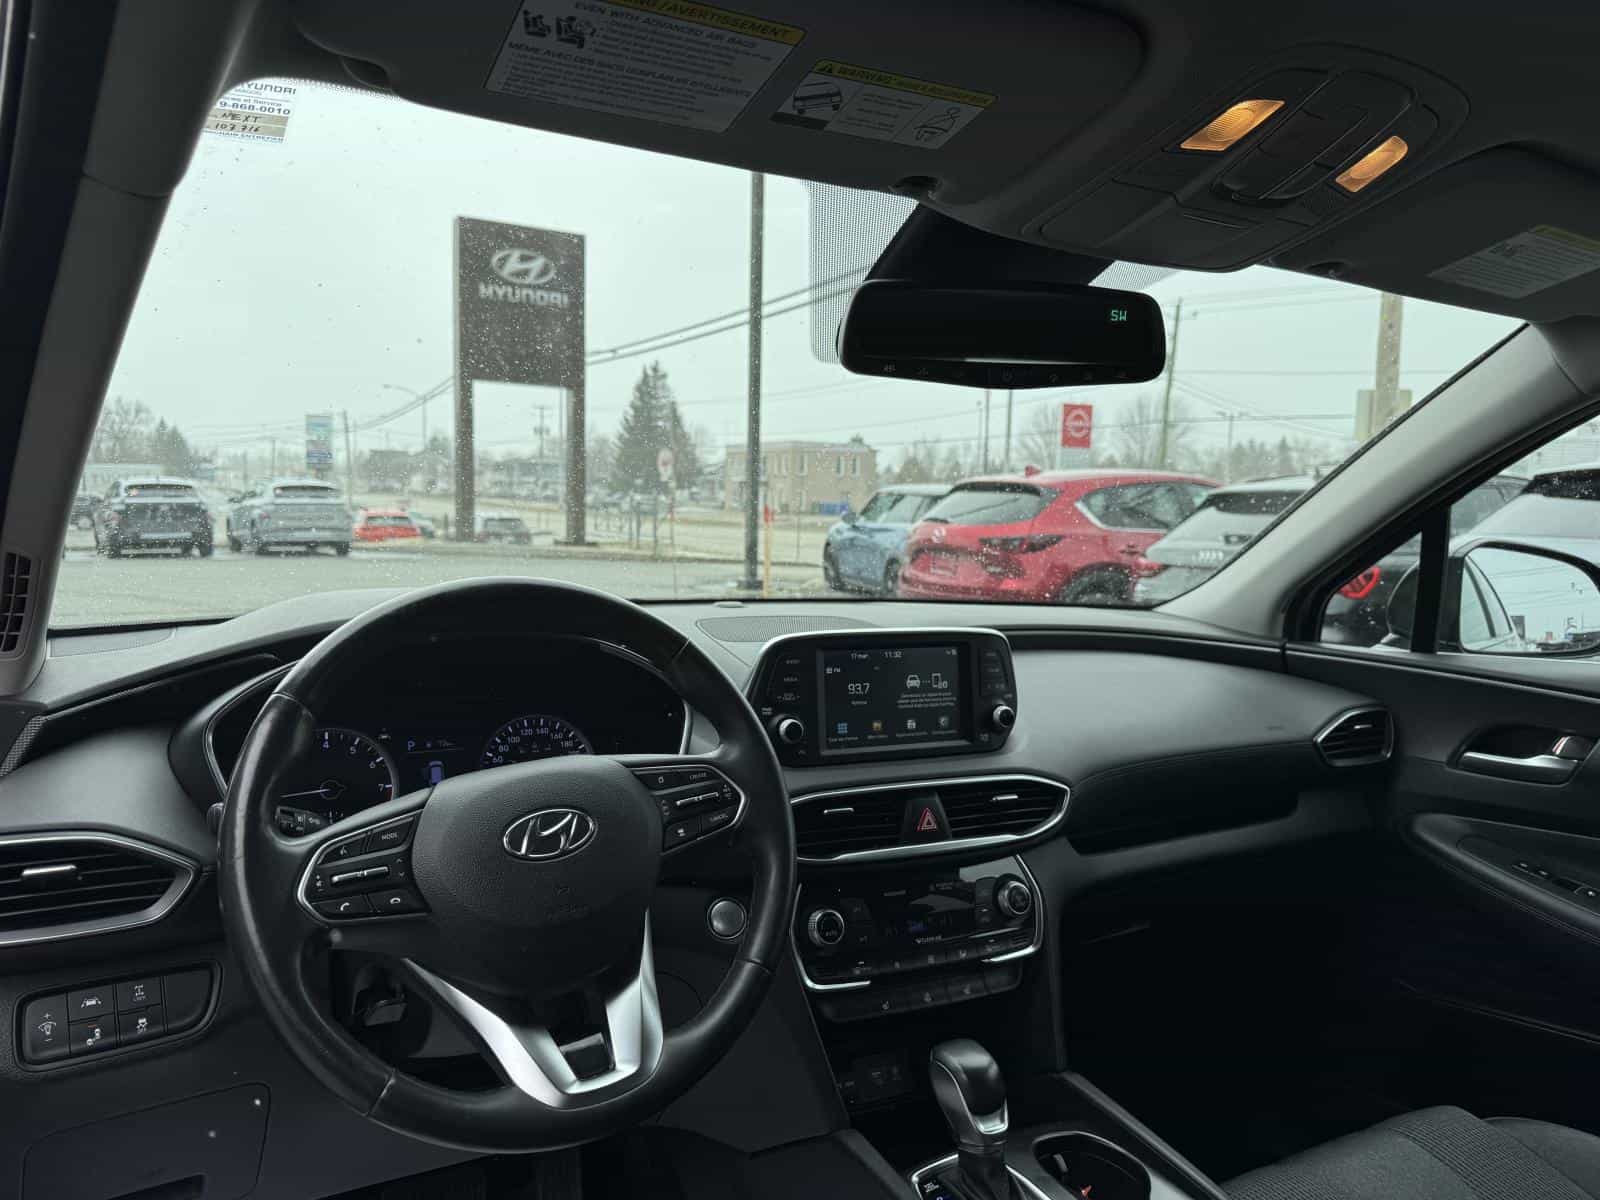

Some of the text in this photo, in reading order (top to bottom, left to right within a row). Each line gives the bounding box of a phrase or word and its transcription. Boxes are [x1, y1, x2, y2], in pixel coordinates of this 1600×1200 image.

[478, 282, 569, 307] HYUNDAI
[1110, 309, 1127, 322] SW
[407, 740, 415, 751] P
[381, 832, 398, 840] MODE
